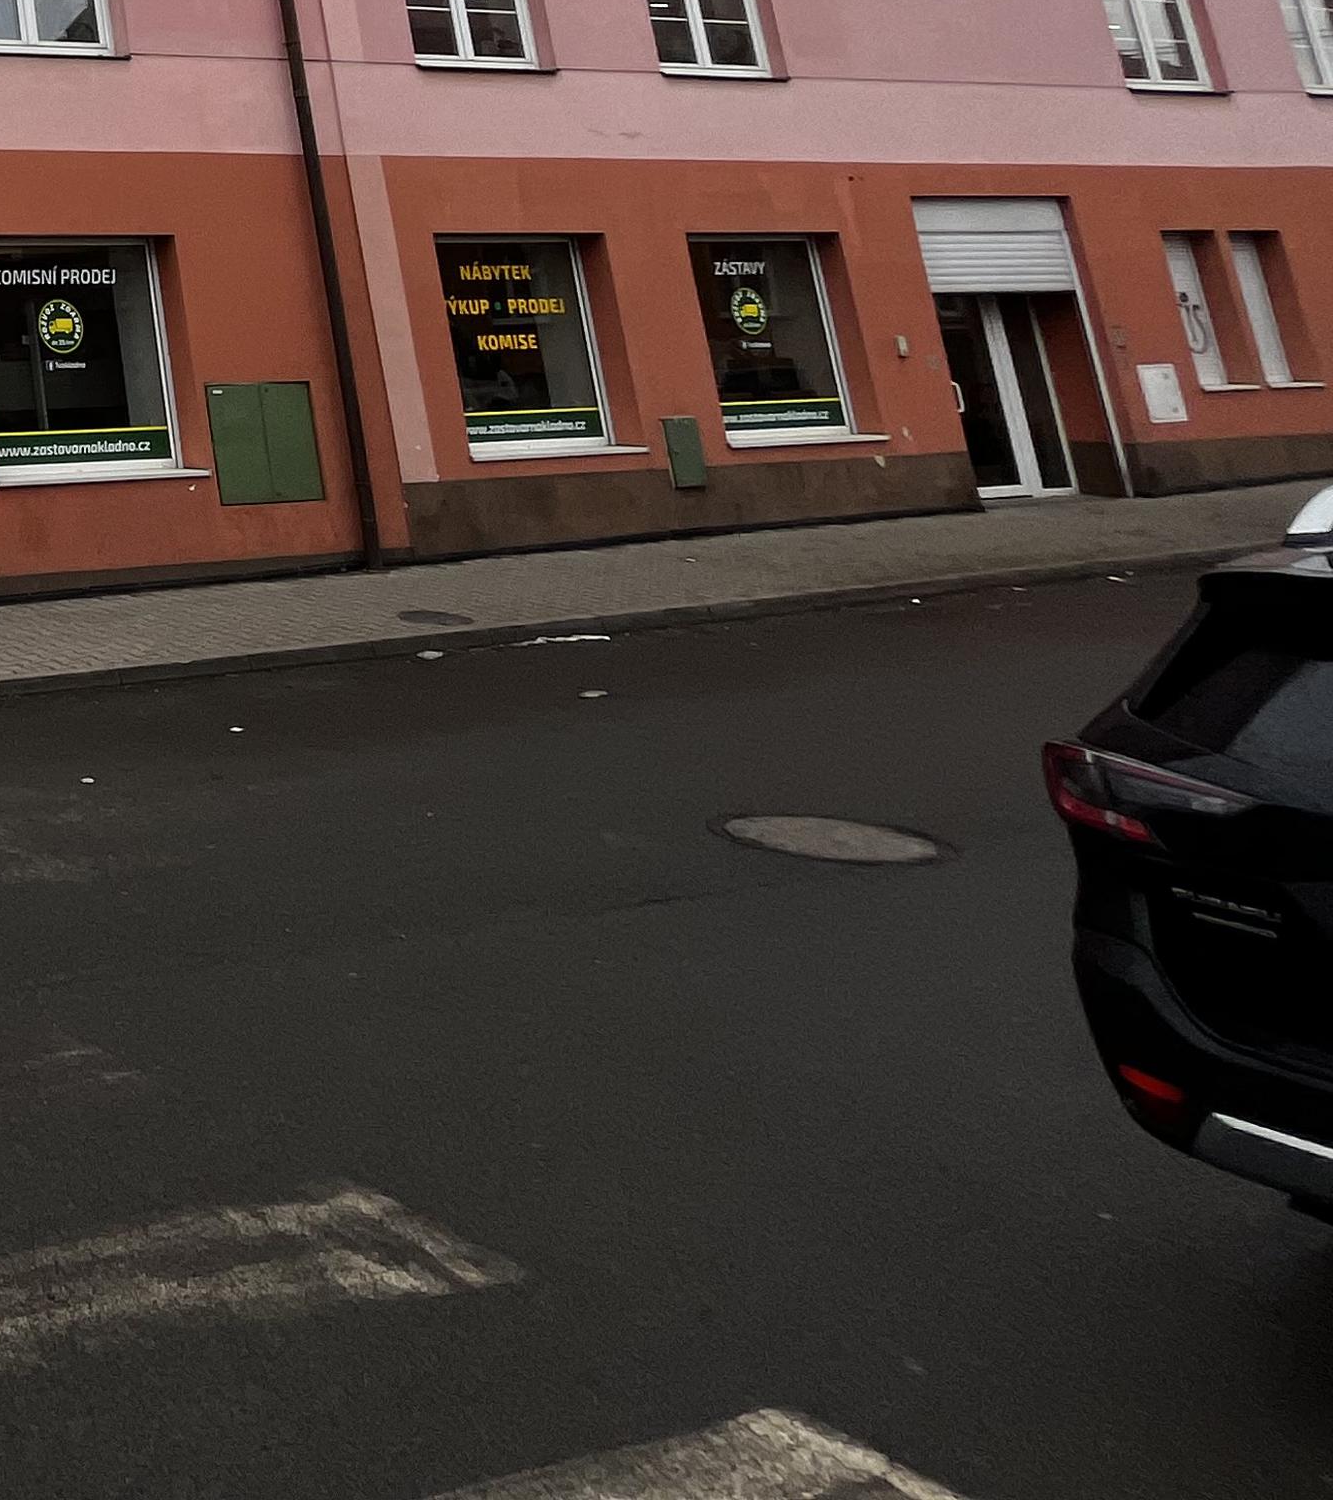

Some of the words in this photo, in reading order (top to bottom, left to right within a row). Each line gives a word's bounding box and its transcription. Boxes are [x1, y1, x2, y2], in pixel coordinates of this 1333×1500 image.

[459, 261, 532, 281] NÁBYTEK
[713, 259, 765, 275] ZÁSTAVY
[60, 269, 116, 285] PRODEJ
[446, 295, 490, 315] ÝKUP
[507, 298, 566, 314] PRODEJ
[477, 334, 538, 350] KOMISE
